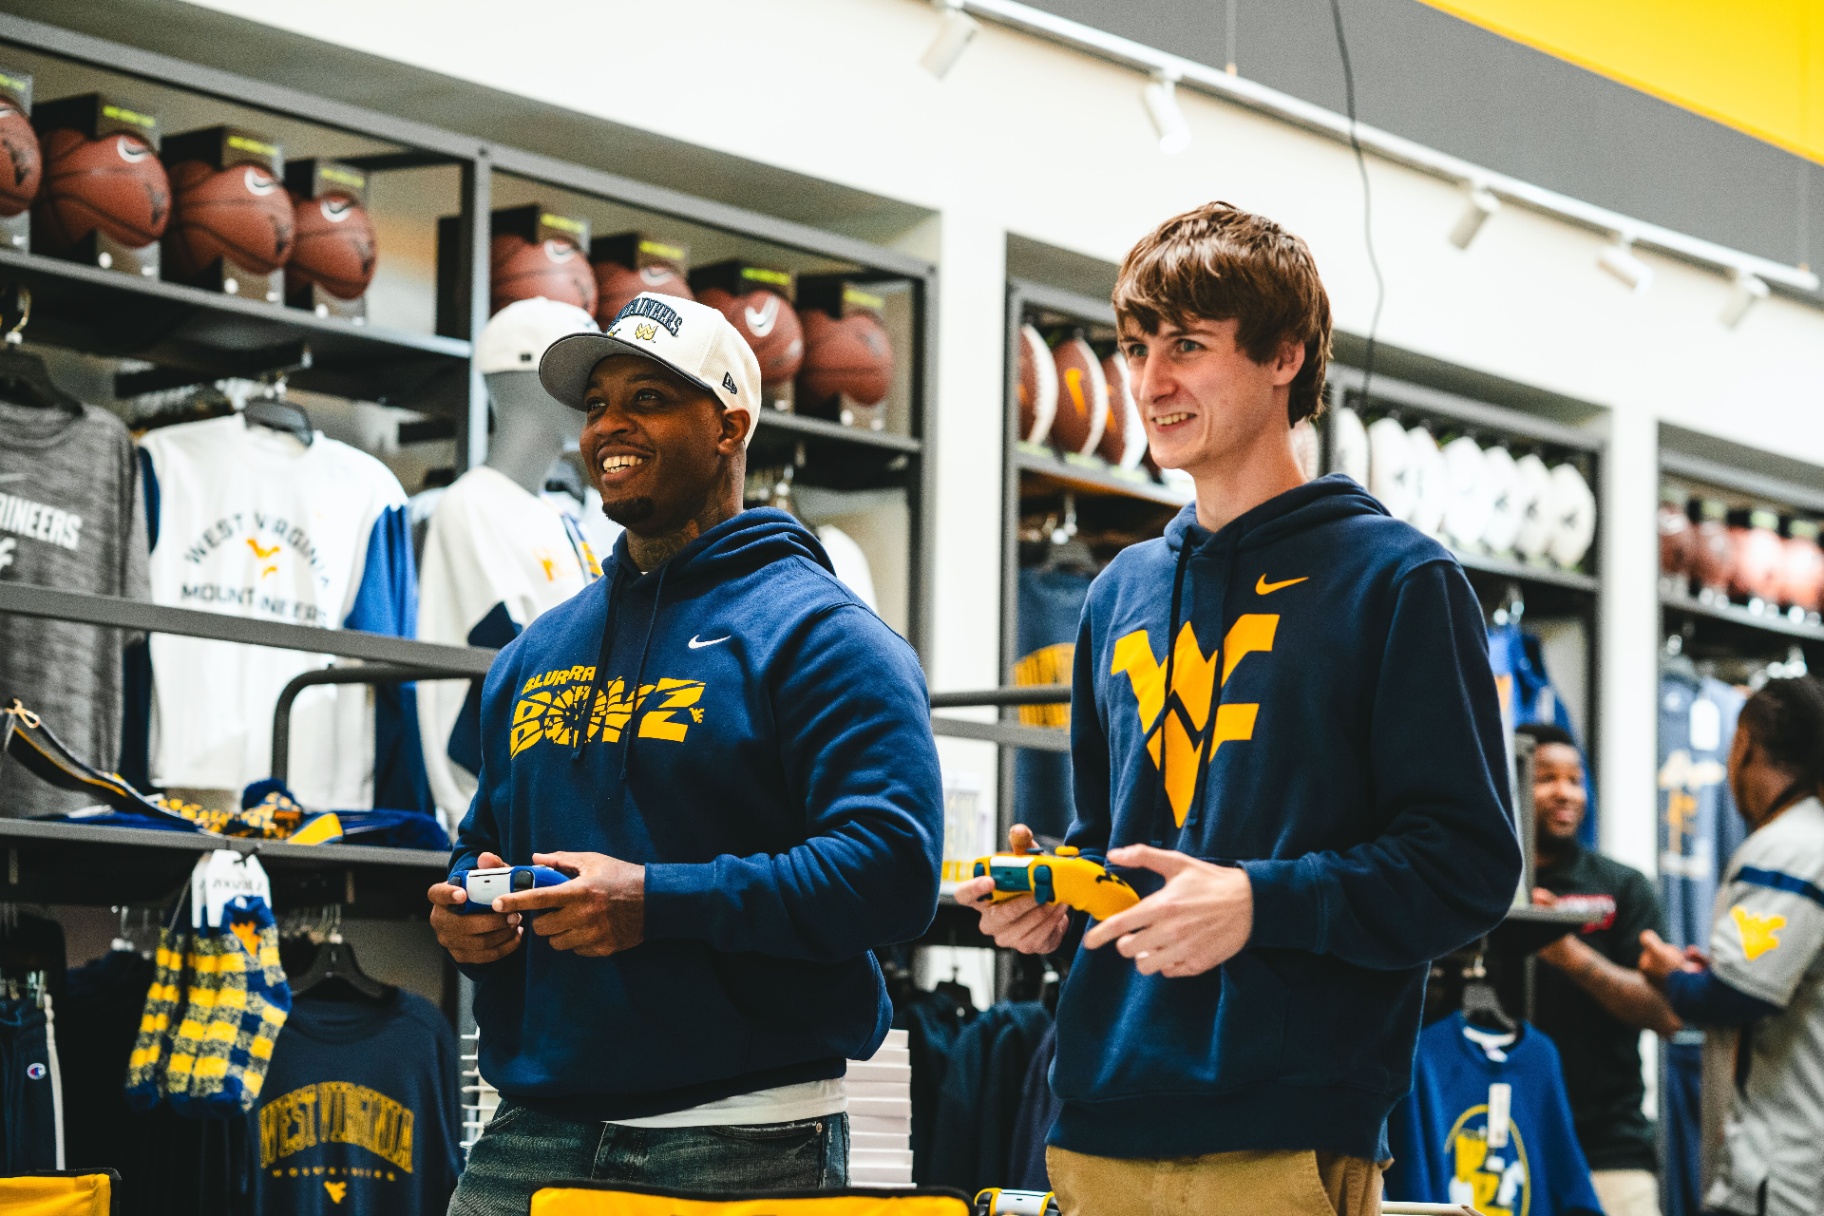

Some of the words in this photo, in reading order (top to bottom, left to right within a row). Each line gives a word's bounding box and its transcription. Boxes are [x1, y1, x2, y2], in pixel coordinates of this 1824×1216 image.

[184, 512, 243, 564] WEST
[258, 1083, 317, 1169] WEST
[316, 1081, 415, 1174] VIRGINIA
